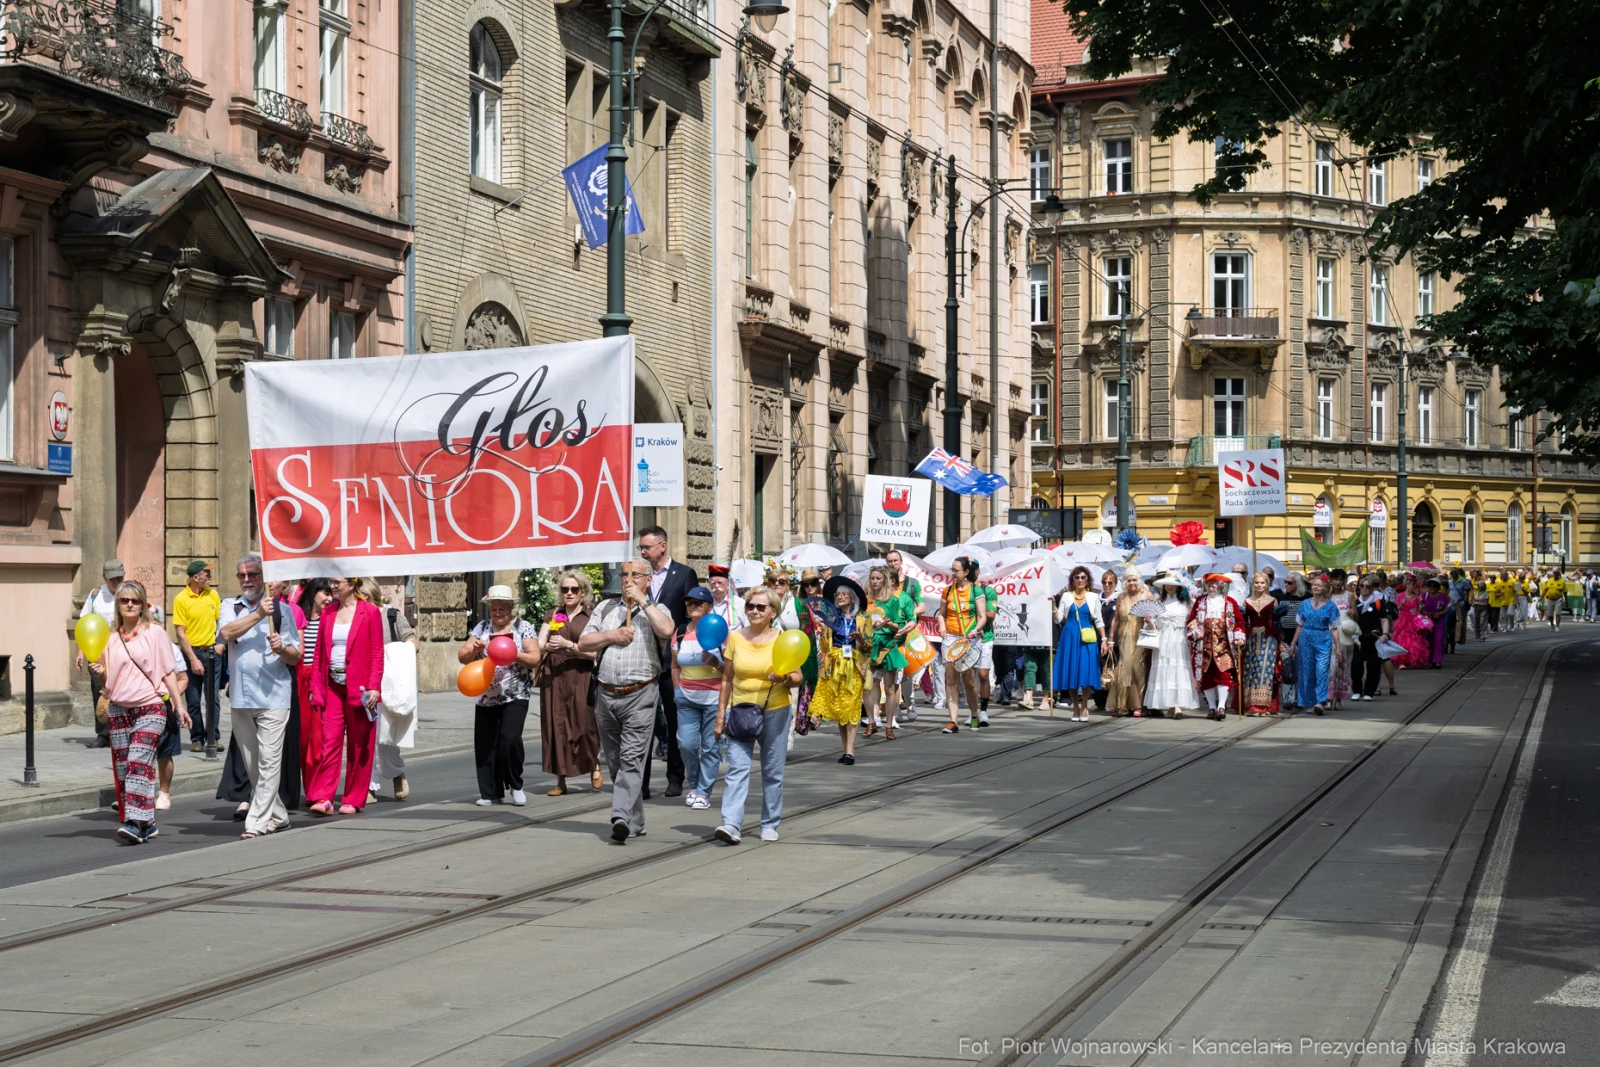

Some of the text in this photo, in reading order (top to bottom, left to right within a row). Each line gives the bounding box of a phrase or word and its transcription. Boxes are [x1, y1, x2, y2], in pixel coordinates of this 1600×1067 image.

[648, 437, 677, 446] Kraków
[1224, 458, 1280, 488] SRS
[1224, 488, 1280, 496] Sochaczewska
[1244, 498, 1280, 506] Seniorów
[876, 518, 912, 527] MIASTO
[865, 528, 922, 538] SOCHACZEW
